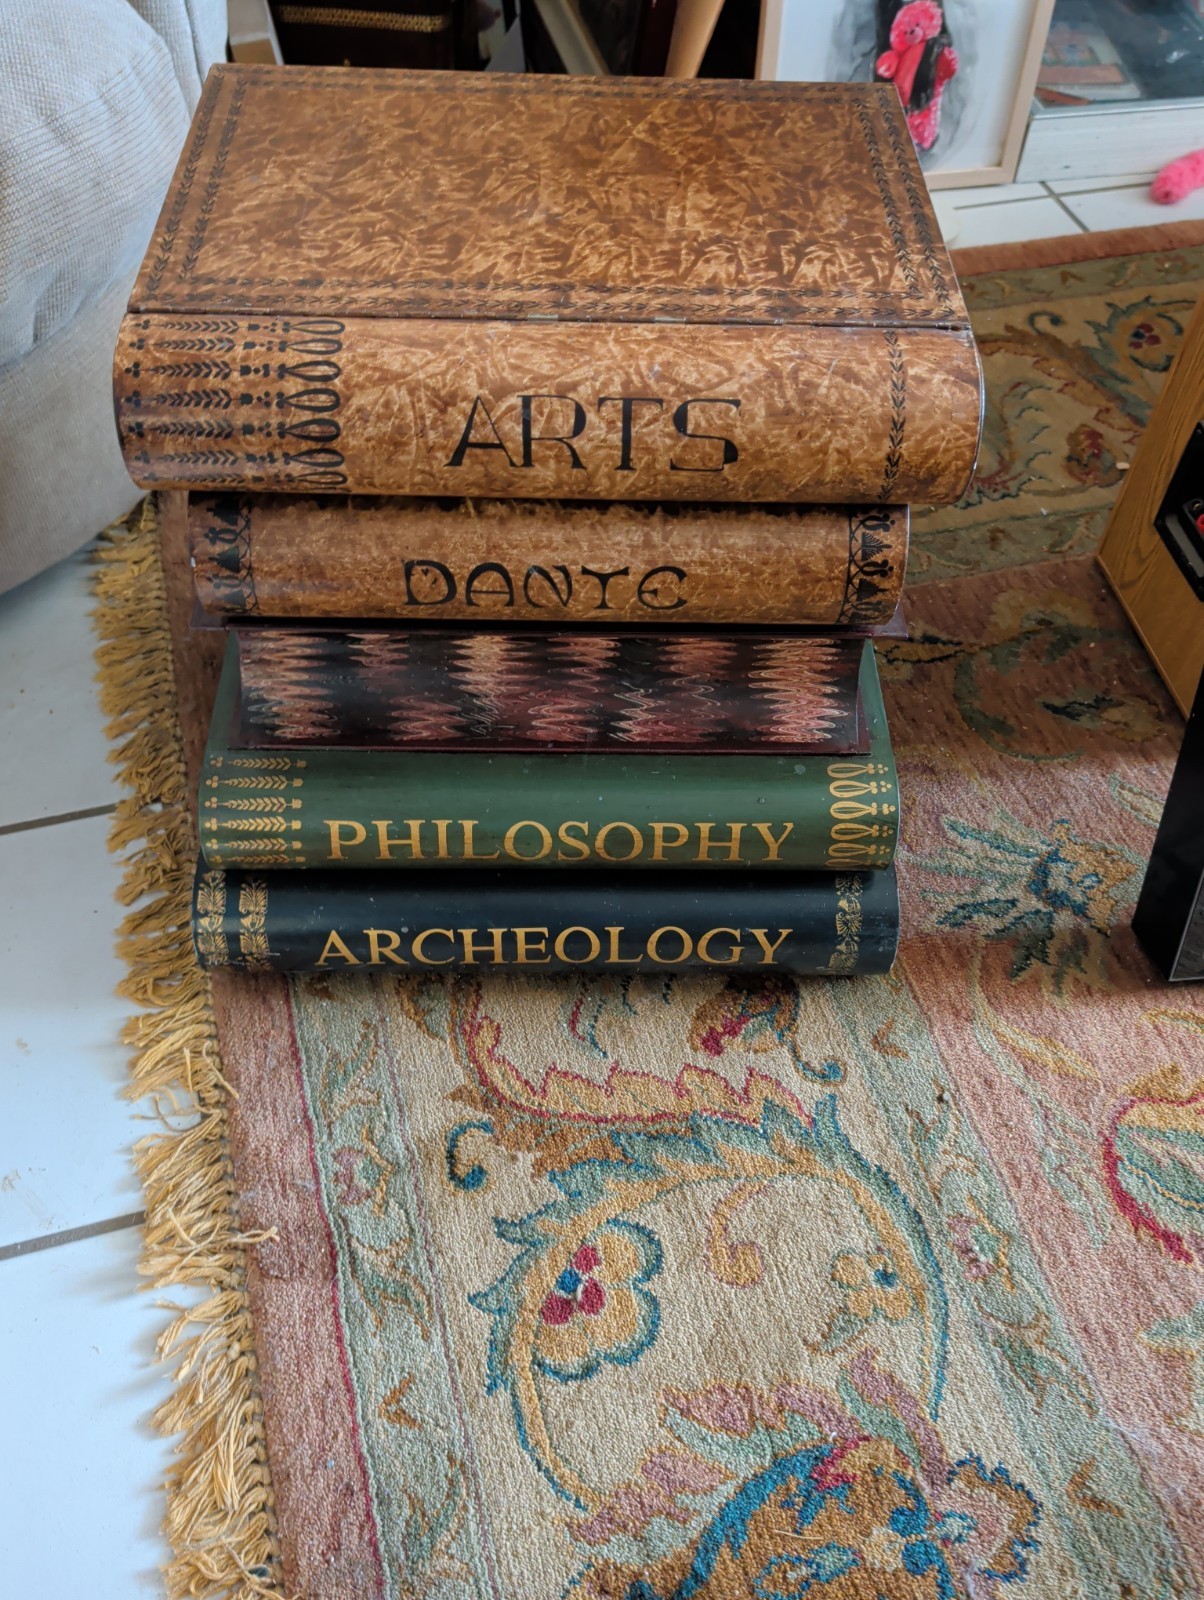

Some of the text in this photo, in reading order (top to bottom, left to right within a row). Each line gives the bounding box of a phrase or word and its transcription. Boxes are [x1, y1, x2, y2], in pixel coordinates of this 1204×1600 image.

[445, 394, 741, 472] ARTS
[403, 560, 688, 610] DANTE
[324, 819, 795, 861] PHILOSOPHY
[315, 926, 793, 966] ARCHEOLOGY
